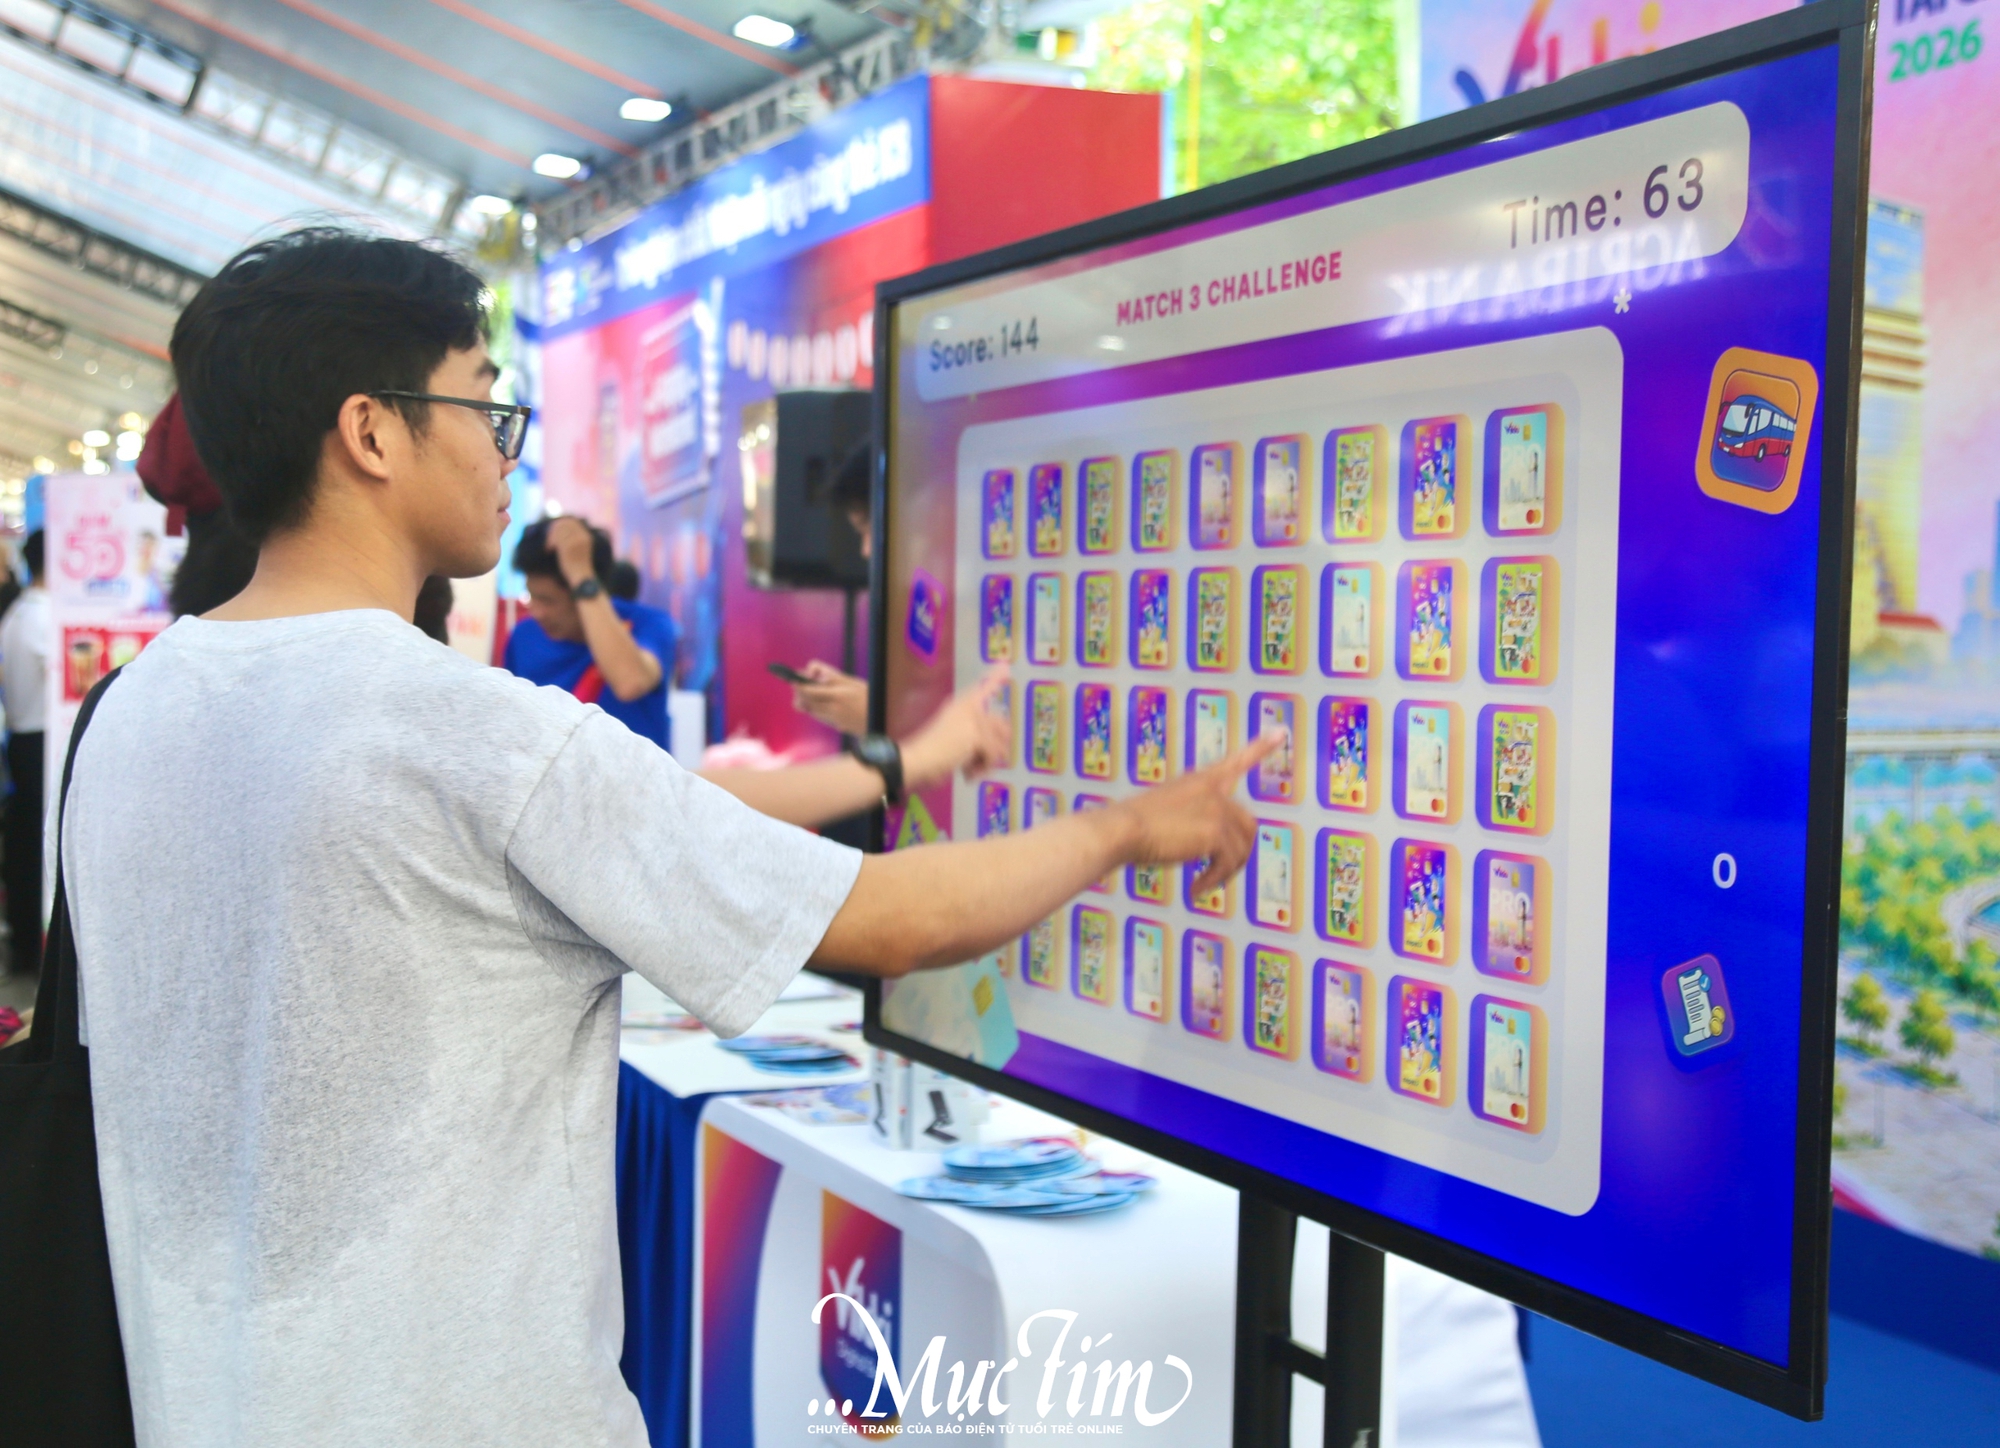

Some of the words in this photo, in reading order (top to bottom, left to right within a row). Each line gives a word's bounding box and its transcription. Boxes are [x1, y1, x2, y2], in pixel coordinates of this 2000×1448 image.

[1888, 19, 1983, 81] 2026
[1503, 189, 1622, 249] Time:
[1643, 157, 1704, 219] 63
[1116, 288, 1183, 326] MATCH
[1189, 284, 1201, 311] 3
[1207, 251, 1342, 306] CHALLENGE
[929, 335, 994, 372] Score:
[1001, 317, 1039, 358] 144
